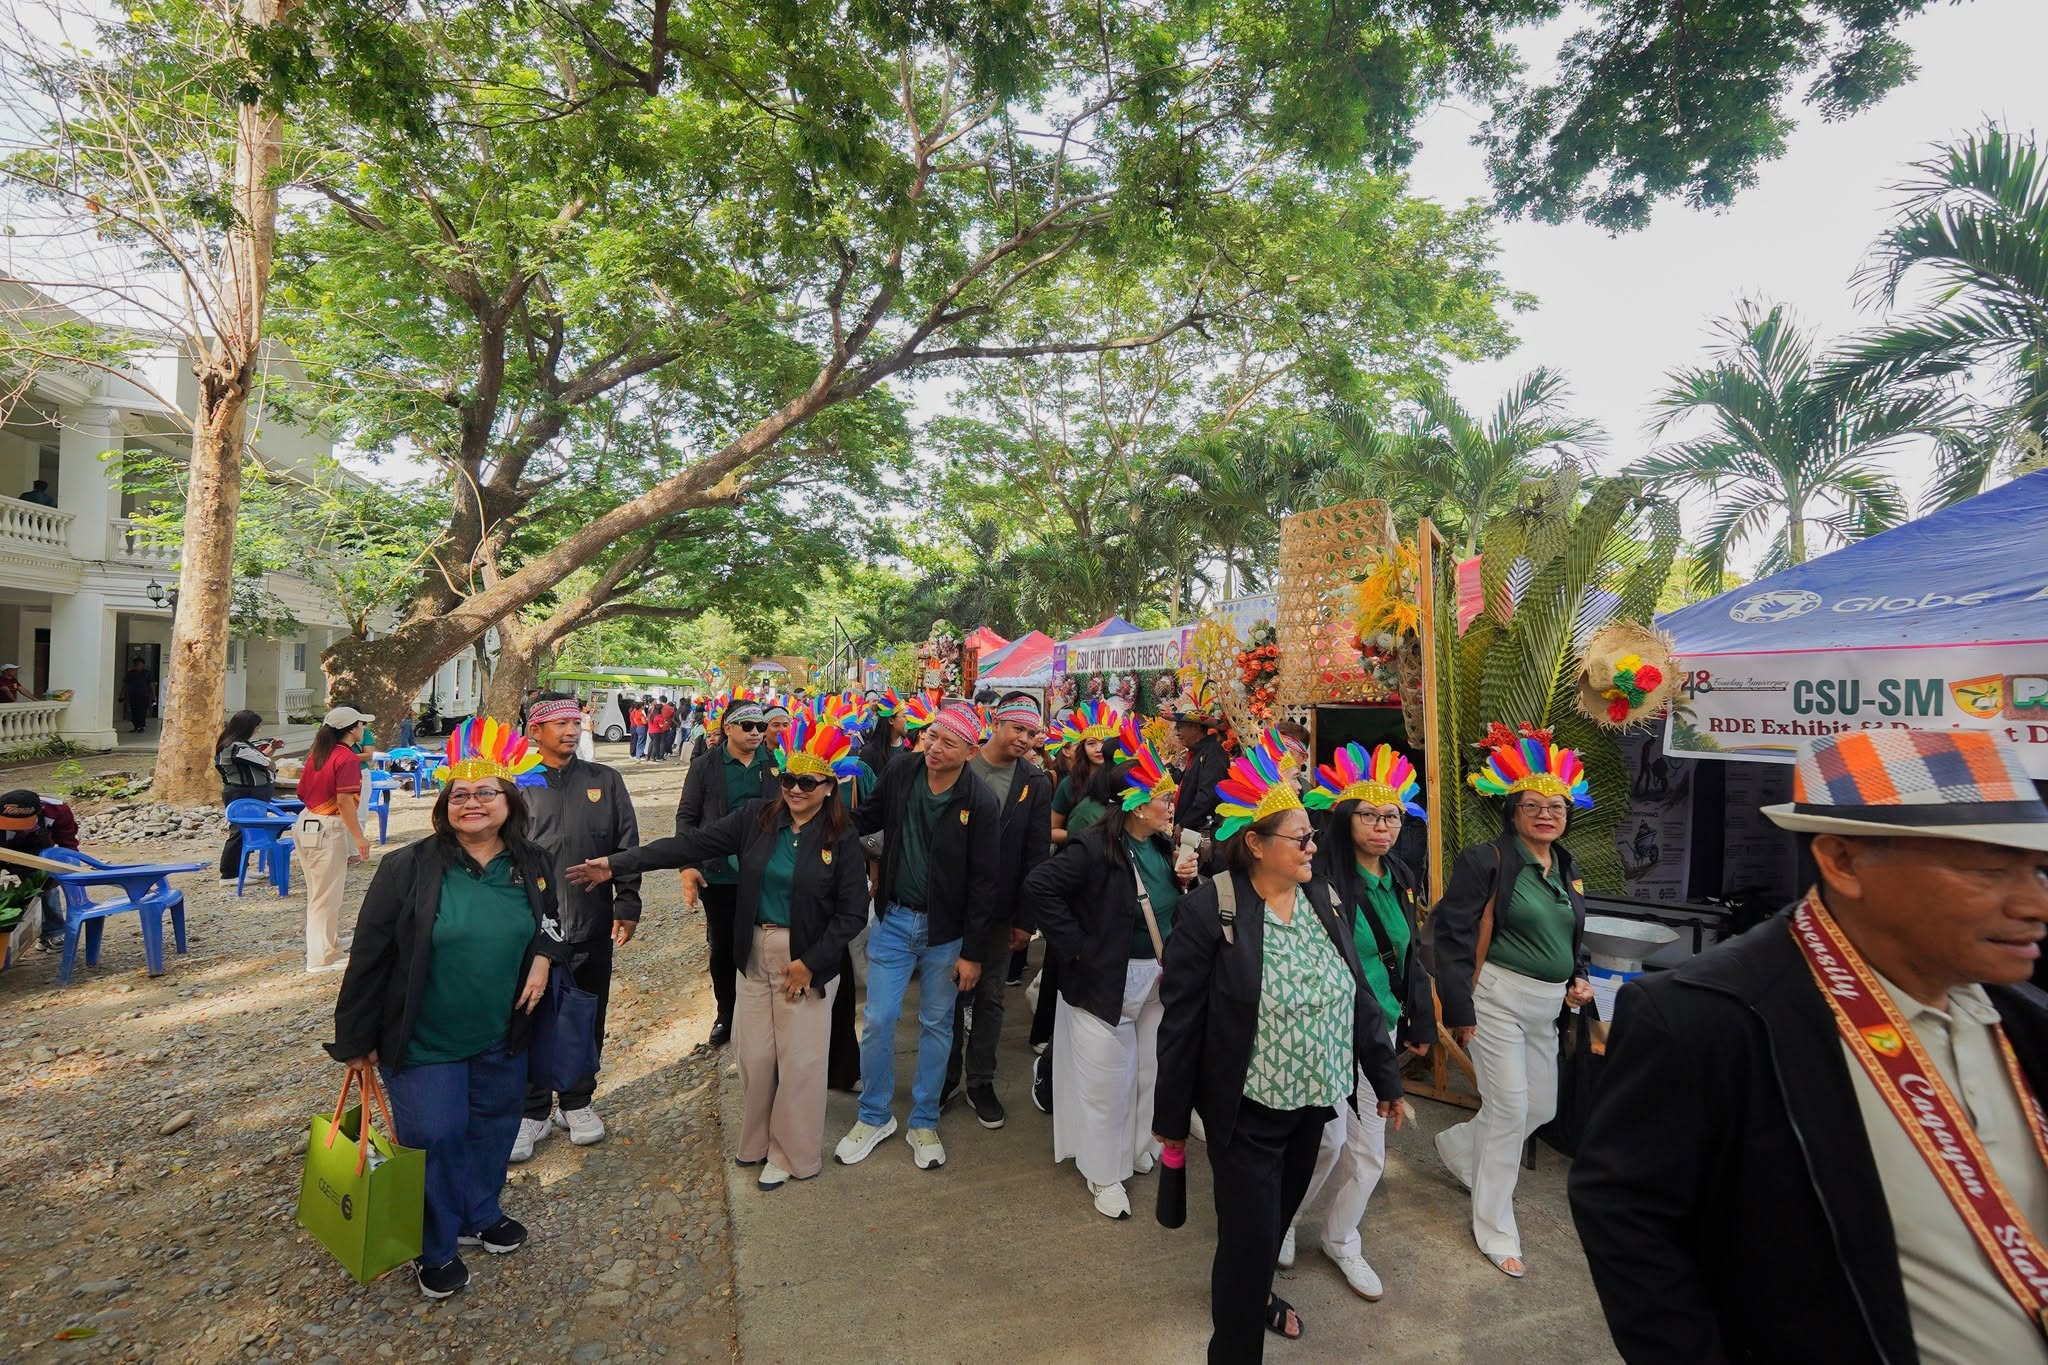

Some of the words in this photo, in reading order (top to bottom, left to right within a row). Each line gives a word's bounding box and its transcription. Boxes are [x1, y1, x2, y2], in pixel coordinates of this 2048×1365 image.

[1831, 592, 1995, 613] Globe
[1076, 650, 1089, 670] CSU
[1137, 644, 1165, 668] FRESH
[1793, 678, 1944, 716] CSU-SM
[1709, 717, 1756, 734] RDE
[1760, 719, 1852, 736] Exhibit
[1899, 1073, 1986, 1199] Cagayan
